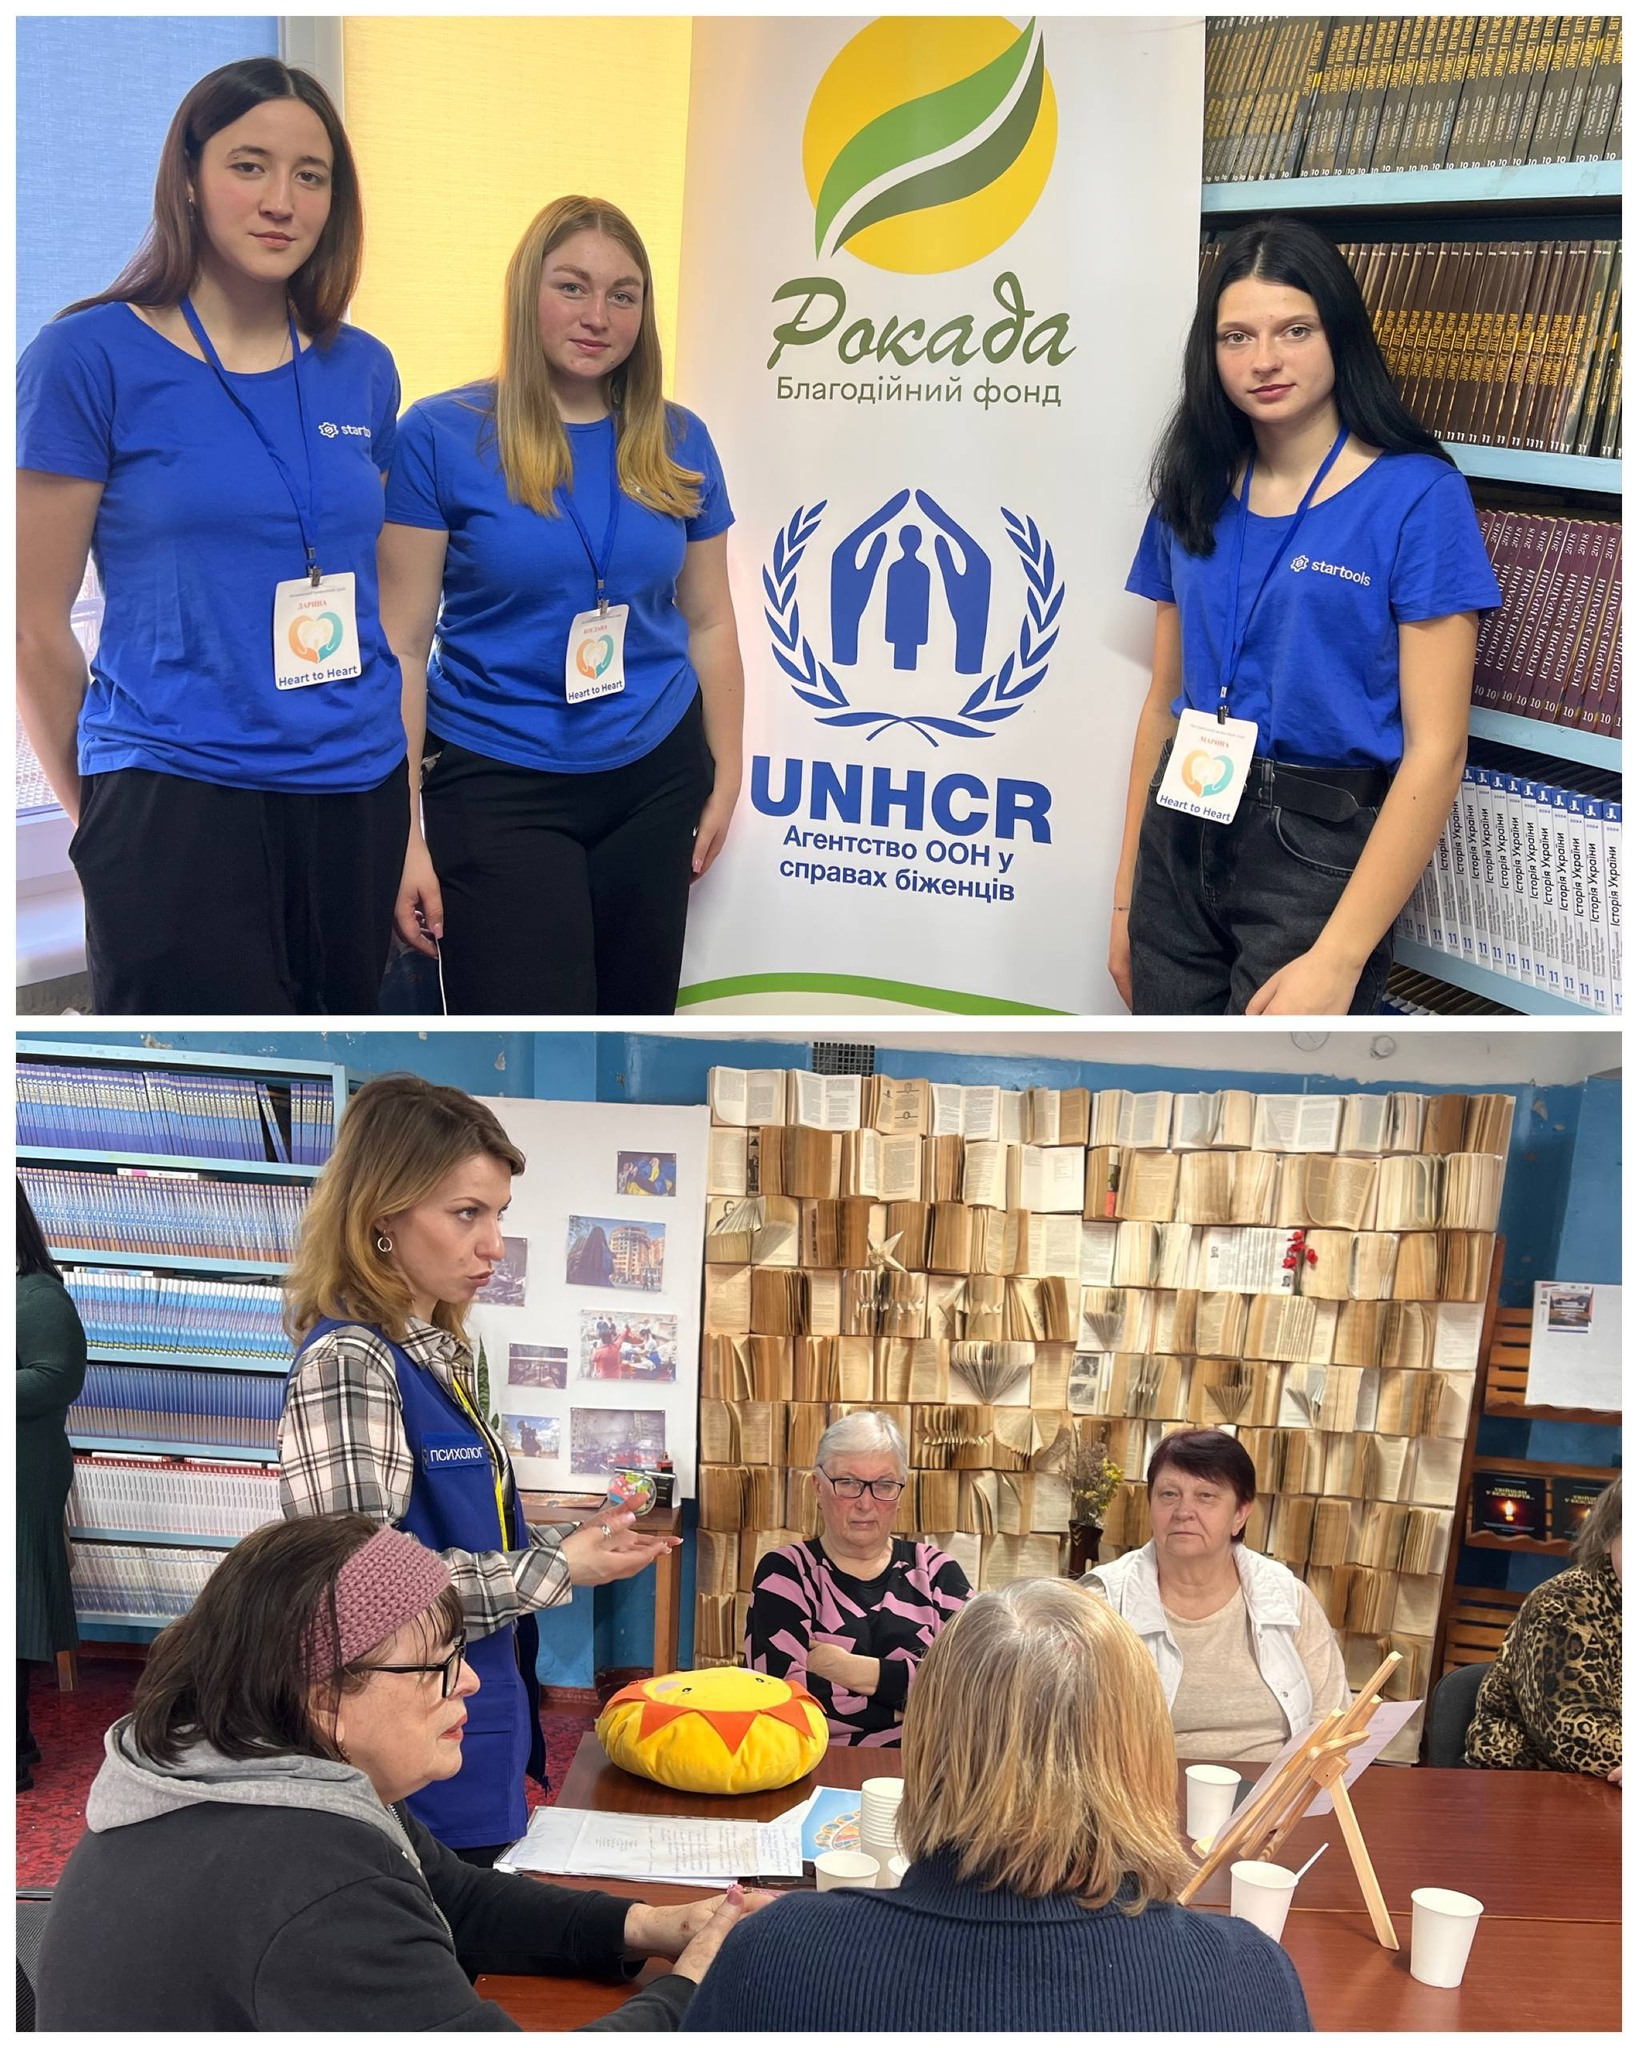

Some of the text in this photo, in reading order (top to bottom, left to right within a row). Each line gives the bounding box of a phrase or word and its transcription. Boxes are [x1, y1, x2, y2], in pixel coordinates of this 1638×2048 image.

[1499, 158, 1507, 166] 10
[1513, 158, 1522, 166] 10
[1542, 156, 1552, 164] 10
[1556, 155, 1566, 163] 10
[766, 271, 1078, 370] Рокада
[776, 375, 1062, 411] Благодійний фонд
[1491, 522, 1501, 543] 2018
[1502, 525, 1512, 546] 2018
[1512, 526, 1523, 548] 2018
[1524, 528, 1536, 549] 2018
[1536, 530, 1548, 552] 2018
[1552, 530, 1563, 552] 2018
[1565, 533, 1576, 555] 2018
[1578, 533, 1590, 555] 2018
[1591, 535, 1602, 557] 2018
[1605, 537, 1616, 560] 2018
[1311, 560, 1371, 586] startools
[1496, 569, 1535, 671] ІСТОРІЯ УКРАЇНИ
[1512, 569, 1550, 672] ІСТОРІЯ УКРАЇНИ
[1526, 572, 1564, 677] ІСТОРІЯ УКРАЇНИ
[1540, 573, 1578, 679] ІСТОРІЯ УКРАЇНИ
[1554, 575, 1591, 682] ІСТОРІЯ УКРАЇНИ
[1484, 620, 1505, 667] ІСТОРІЯ
[1572, 578, 1606, 687] ІСТОРІЯ УКРАЇНИ
[1590, 581, 1622, 690] ІСТОРІЯ УКРАЇНИ
[279, 665, 357, 686] Heart to Heart
[568, 681, 623, 700] Heart to Heart
[1474, 685, 1484, 695] 10
[1486, 689, 1496, 699] 10
[1502, 691, 1512, 702] 10
[1516, 695, 1527, 706] 10
[1530, 698, 1540, 708] 10
[1544, 701, 1555, 711] 10
[1563, 706, 1574, 718] 10
[1582, 711, 1593, 722] 10
[1600, 713, 1611, 724] 10
[750, 755, 1052, 844] UNHCR
[1160, 794, 1231, 821] Heart to Heart
[783, 825, 1014, 874] Агентство ООН у
[1466, 805, 1480, 879] Історія України
[1481, 809, 1494, 883] Історія України
[1496, 813, 1510, 889] Історія України
[1438, 838, 1448, 870] Історія
[1454, 842, 1465, 875] Історія
[1511, 817, 1524, 893] Історія України
[1526, 822, 1540, 899] Історія України
[1540, 828, 1554, 905] Історія України
[1556, 833, 1569, 911] Історія України
[1571, 838, 1585, 917] Історія України
[779, 860, 1015, 903] справах біженців
[1587, 843, 1601, 922] Історія України
[1607, 846, 1622, 926] Історія України
[1434, 929, 1441, 940] 11
[1449, 933, 1457, 944] 11
[1464, 937, 1471, 949] 11
[1479, 942, 1487, 953] 11
[1493, 947, 1501, 959] 11
[1507, 953, 1516, 965] 11
[1521, 958, 1530, 970] 11
[1536, 964, 1544, 976] 11
[1550, 971, 1558, 983] 11
[1565, 976, 1574, 989] 11
[1580, 983, 1589, 995] 11
[1595, 989, 1604, 1001] 11
[430, 1447, 484, 1462] ПСИХОЛОГ
